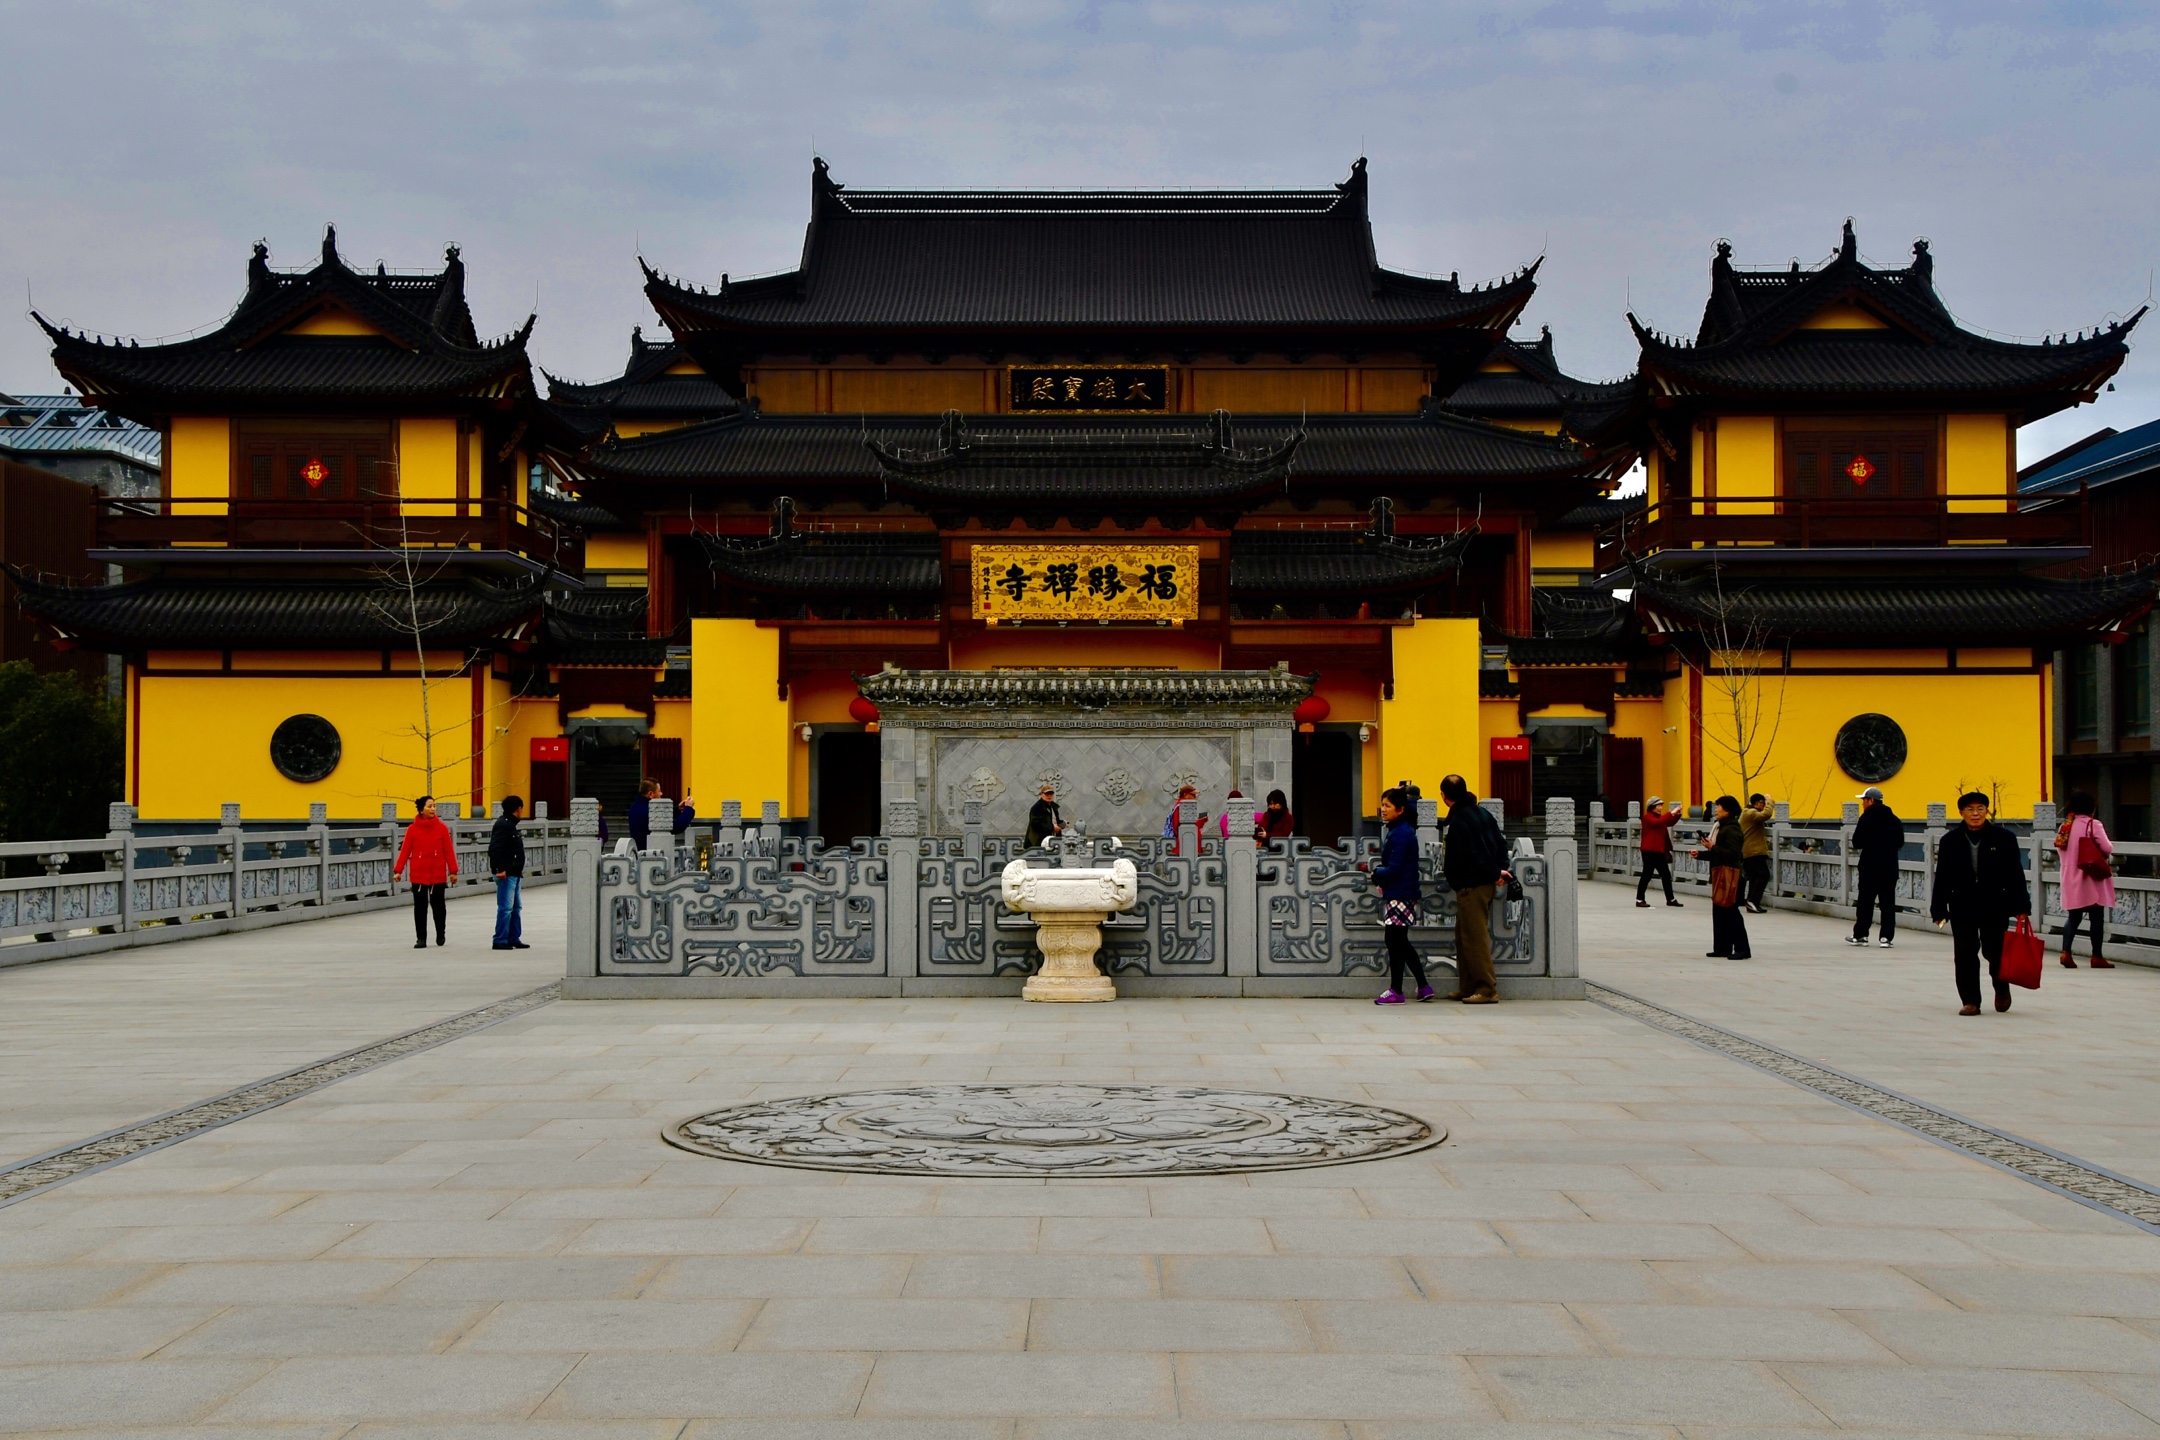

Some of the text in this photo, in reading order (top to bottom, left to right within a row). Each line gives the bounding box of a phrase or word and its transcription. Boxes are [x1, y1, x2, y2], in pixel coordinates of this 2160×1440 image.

[1028, 376, 1152, 402] 大雄寶殿
[308, 465, 322, 480] 福
[1852, 462, 1867, 477] 福
